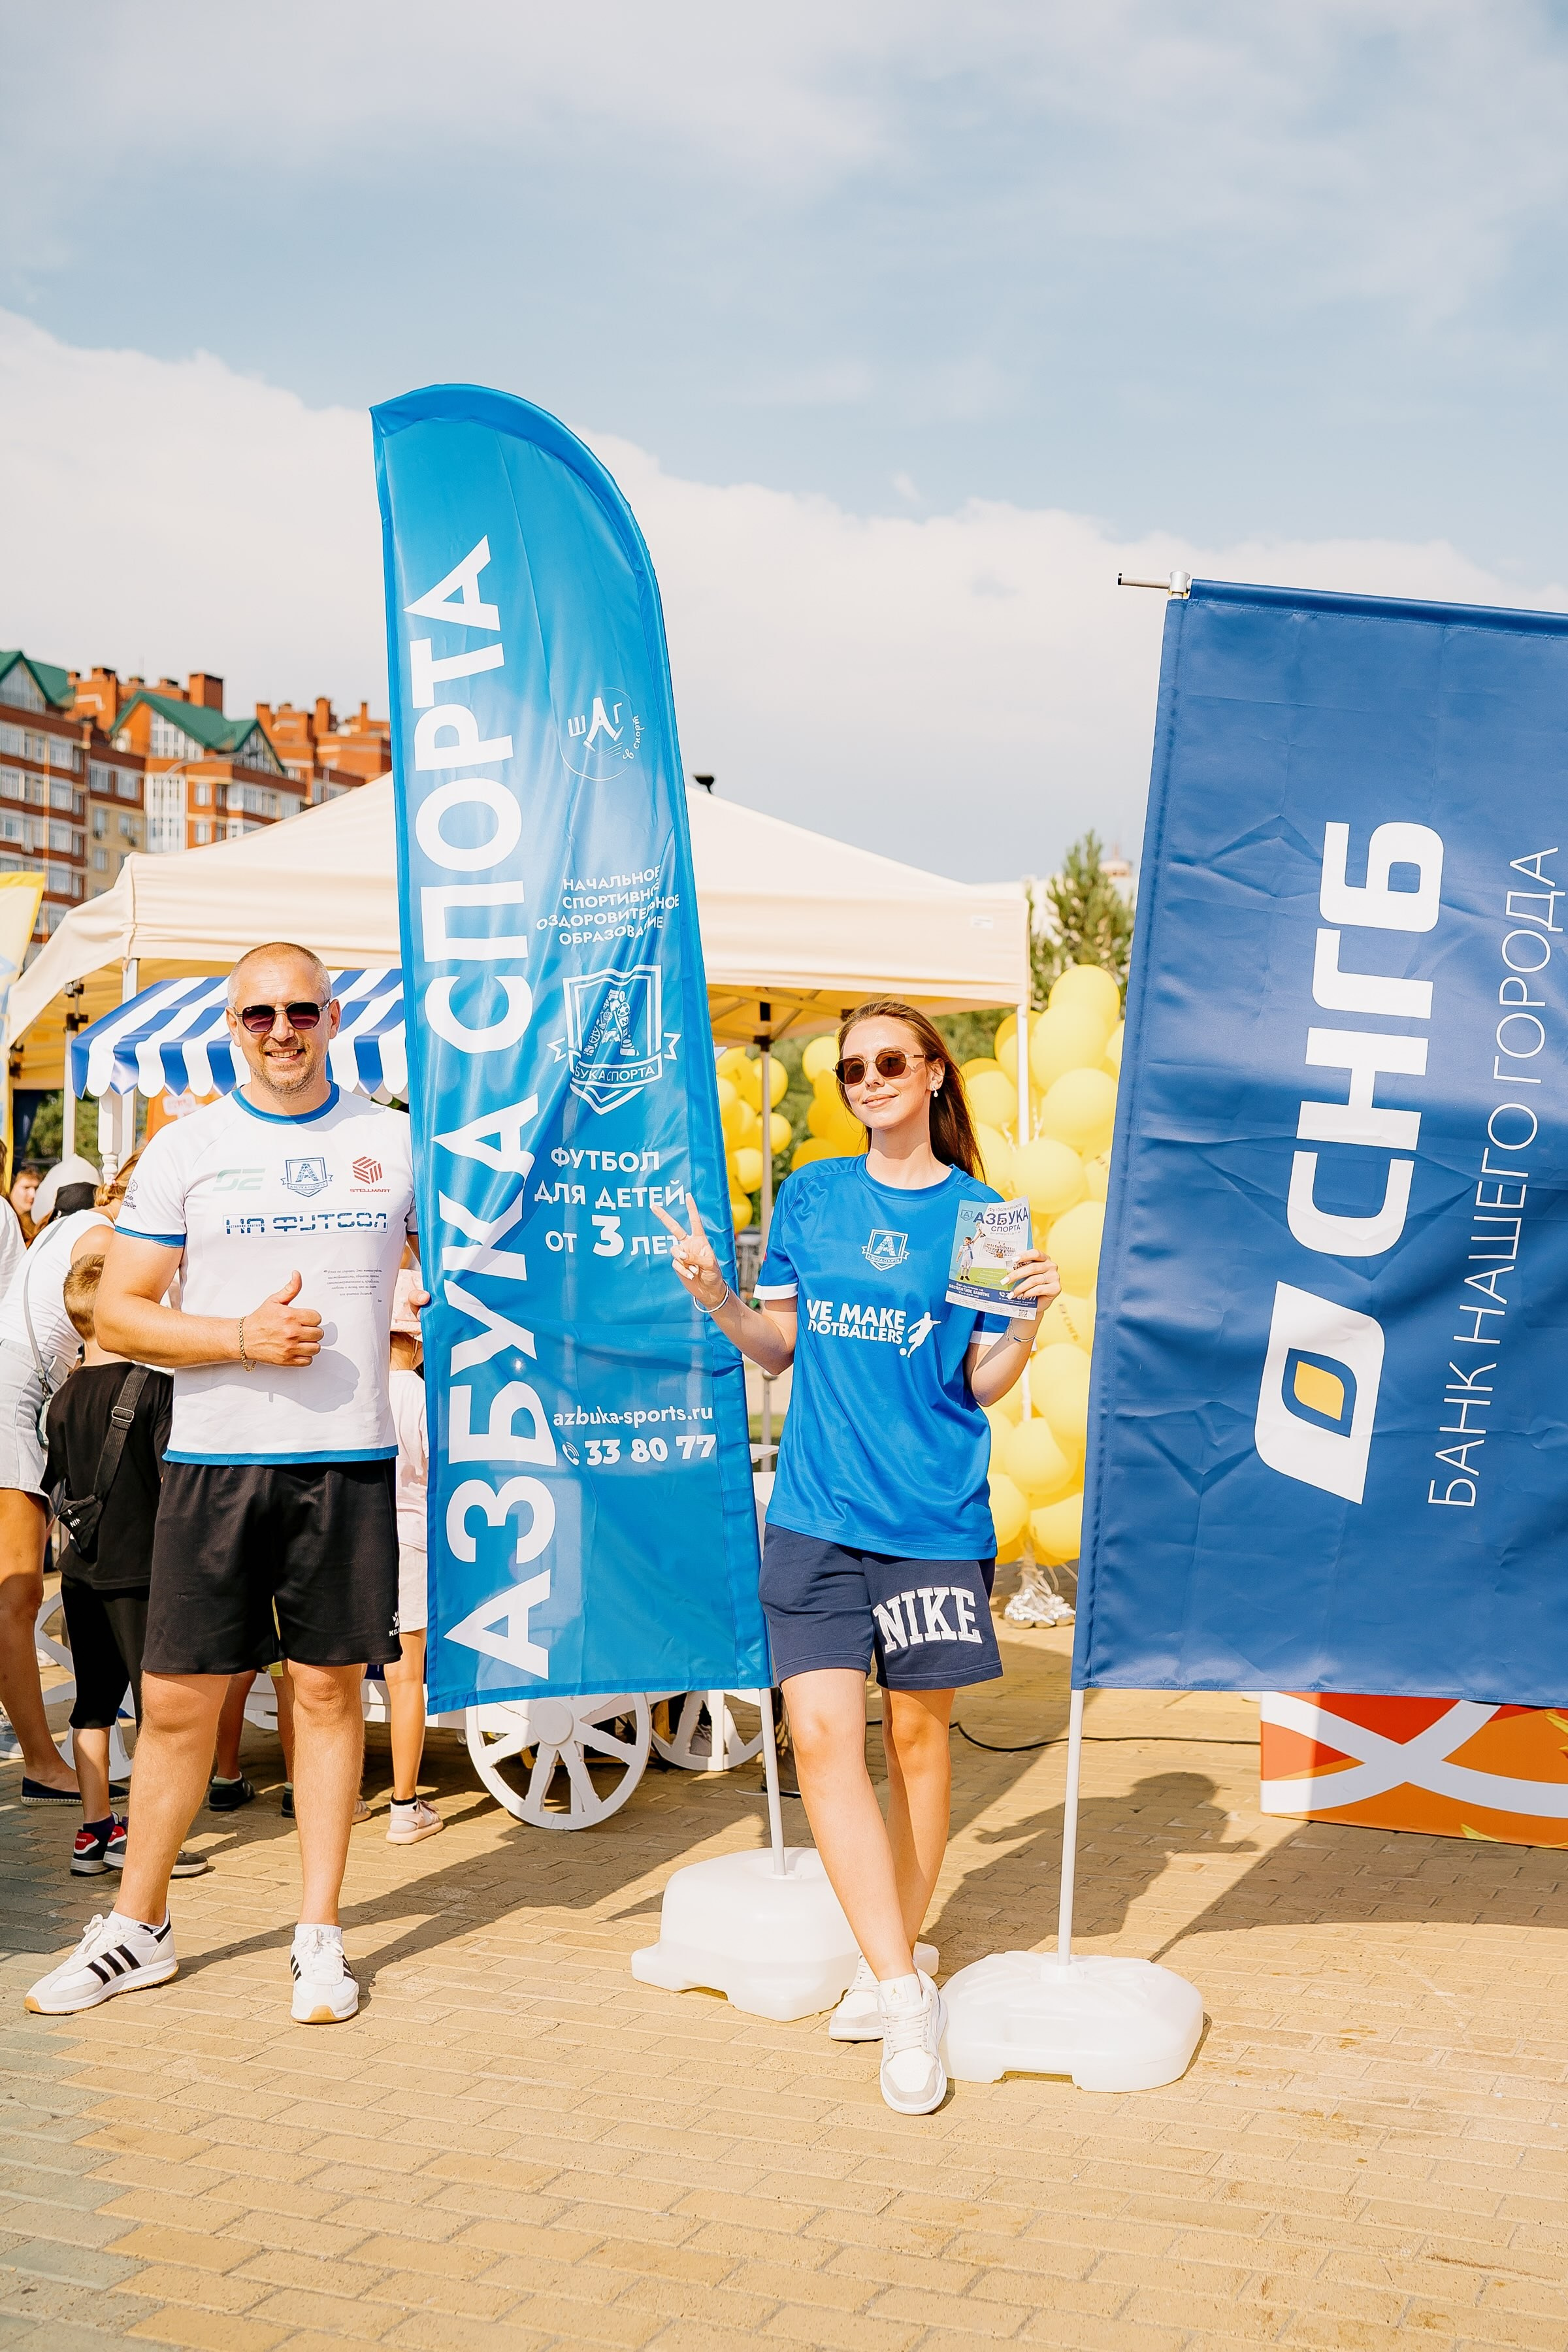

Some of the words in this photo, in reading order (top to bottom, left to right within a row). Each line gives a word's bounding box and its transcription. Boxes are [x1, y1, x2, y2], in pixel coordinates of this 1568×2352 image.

[402, 534, 534, 1054] СПОРТА
[1493, 847, 1566, 1085] ГОРОДА
[1286, 821, 1445, 1258] СНГБ
[575, 1067, 605, 1081] БУКА
[606, 1066, 655, 1082] СПОРТА
[551, 1147, 660, 1173] ФУТБОЛ
[534, 1180, 586, 1205] ДЛЯ
[595, 1179, 685, 1211] ДЕТЕЙ
[545, 1230, 578, 1253] ОТ
[591, 1215, 625, 1257] 3
[973, 1207, 1029, 1226] АЗБУКА
[1454, 1102, 1539, 1345] НАШЕГО
[839, 1303, 907, 1331] MAKE
[429, 1092, 557, 1680] АЗБУКА
[553, 1405, 713, 1429] azbuka-sports.ru
[1428, 1361, 1497, 1507] БАНК
[585, 1439, 621, 1466] 33
[630, 1437, 668, 1463] 80
[676, 1434, 717, 1460] 77
[872, 1586, 983, 1654] NIKE
